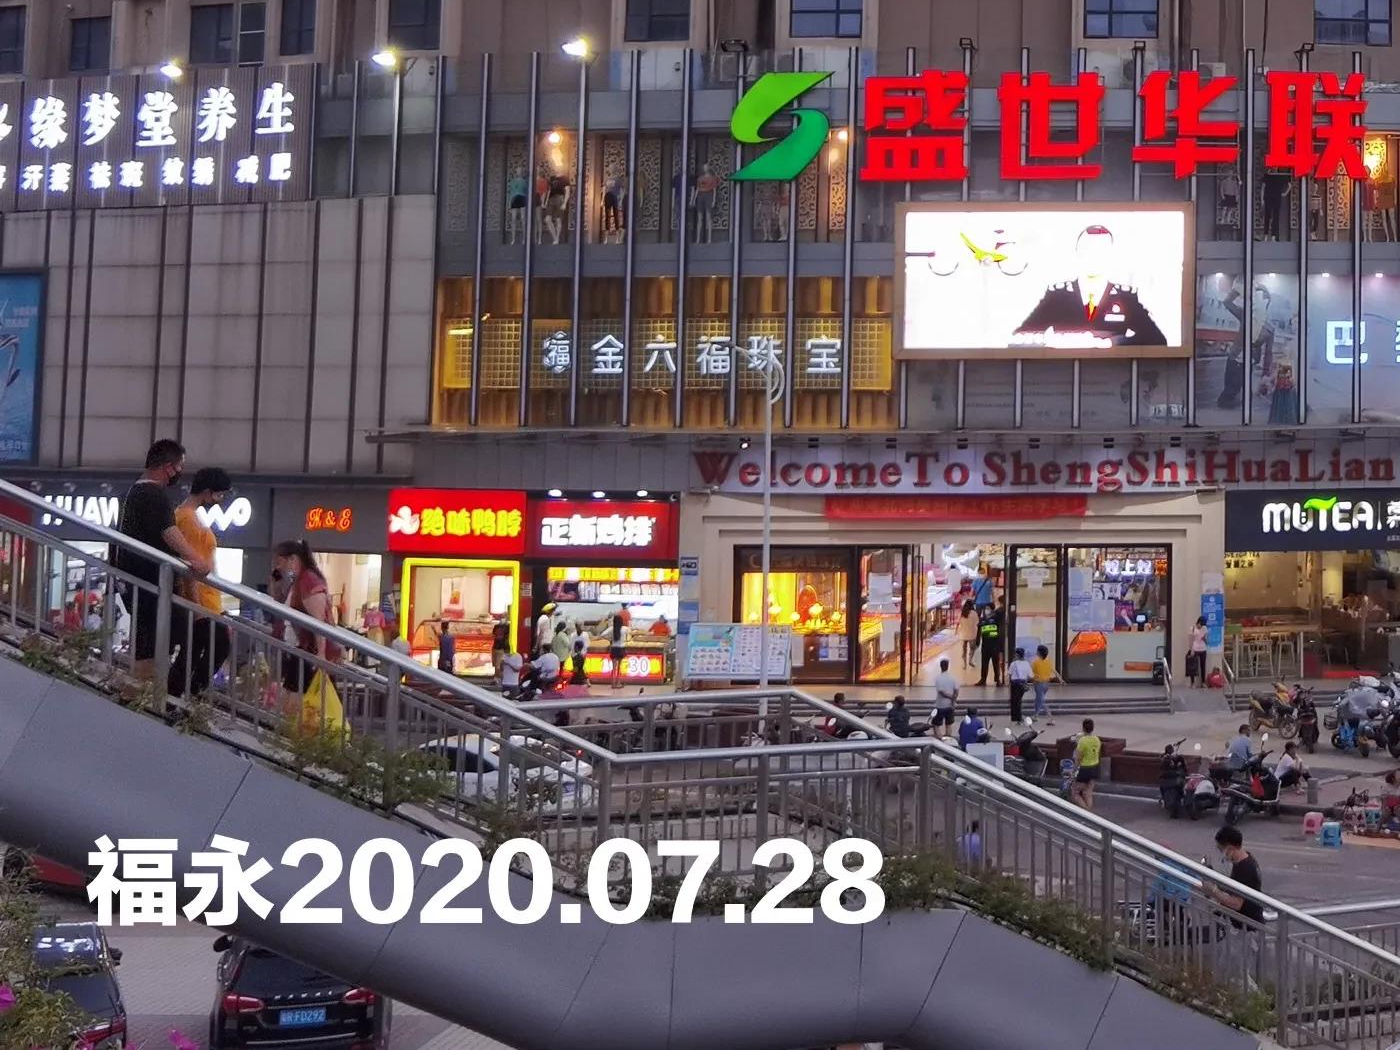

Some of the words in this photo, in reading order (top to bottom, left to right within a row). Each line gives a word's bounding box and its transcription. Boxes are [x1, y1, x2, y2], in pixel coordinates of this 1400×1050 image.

[860, 69, 1368, 180] 盛世华联
[420, 507, 523, 537] 绝味鸭脖
[541, 514, 654, 546] 正新鸡排
